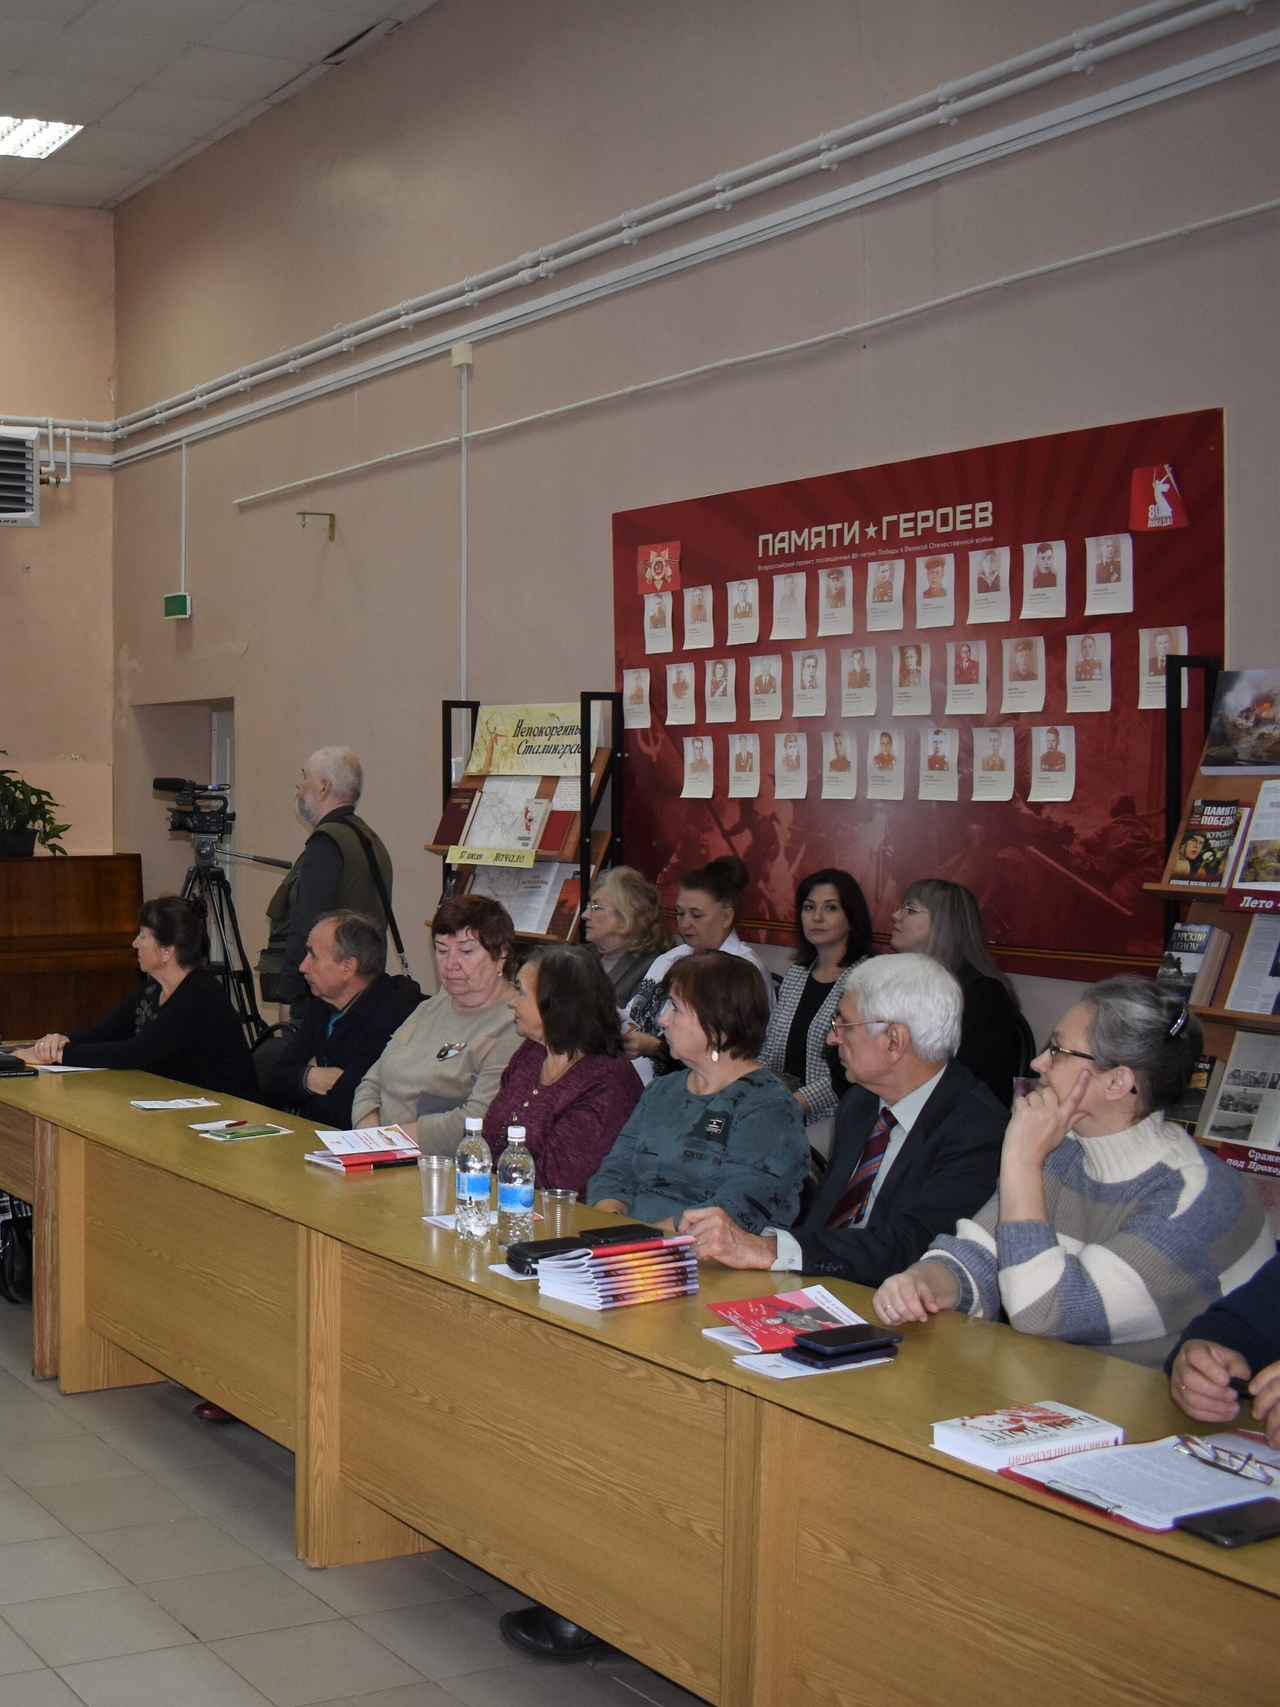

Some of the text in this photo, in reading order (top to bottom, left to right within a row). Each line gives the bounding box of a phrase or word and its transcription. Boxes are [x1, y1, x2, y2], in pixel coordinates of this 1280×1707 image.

[758, 501, 993, 557] ПАМЯТИ ГЕРОЕВ
[758, 561, 795, 571] Всероссийский
[795, 558, 815, 568] проект,
[877, 547, 900, 556] Победы
[904, 543, 928, 553] Великой
[929, 538, 974, 549] Отечественной
[975, 535, 994, 544] войне
[1239, 896, 1274, 909] Лето
[1226, 1158, 1245, 1168] под
